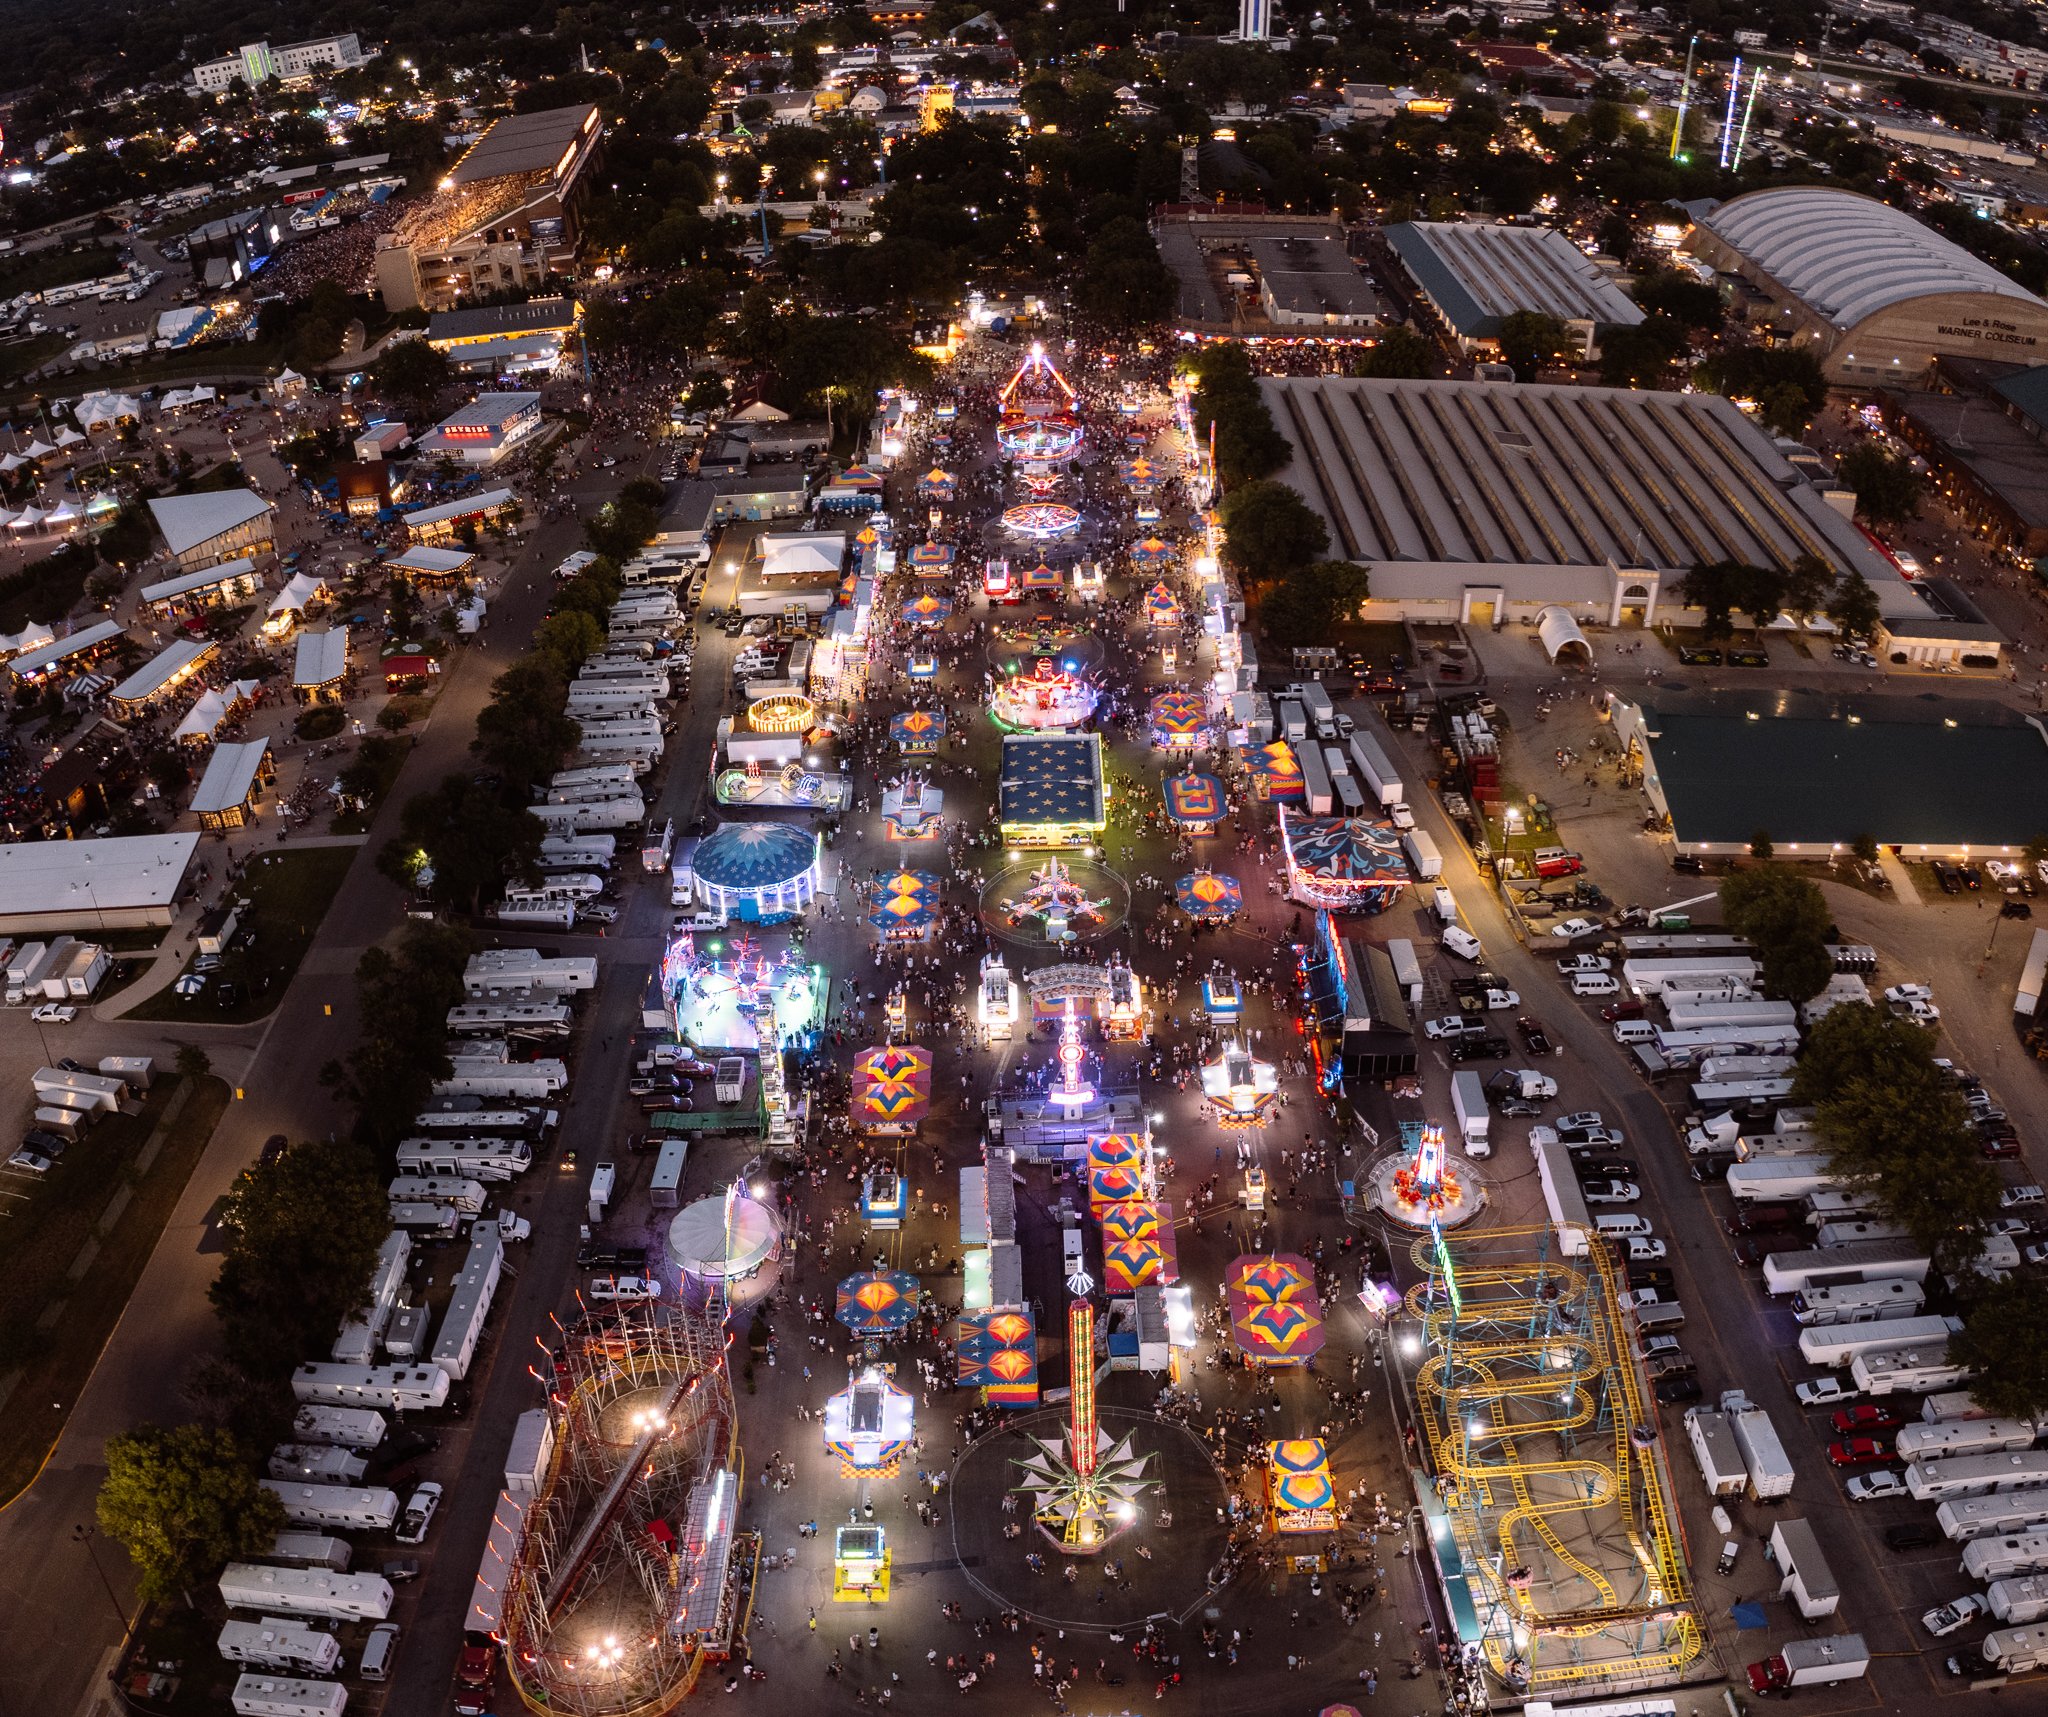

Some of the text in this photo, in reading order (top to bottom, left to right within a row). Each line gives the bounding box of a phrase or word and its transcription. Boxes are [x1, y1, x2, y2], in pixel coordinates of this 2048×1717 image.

[1963, 318, 2017, 332] Lee & Rose
[1938, 326, 2036, 345] WARNER COLISEUM
[444, 425, 489, 434] SKYRIDE
